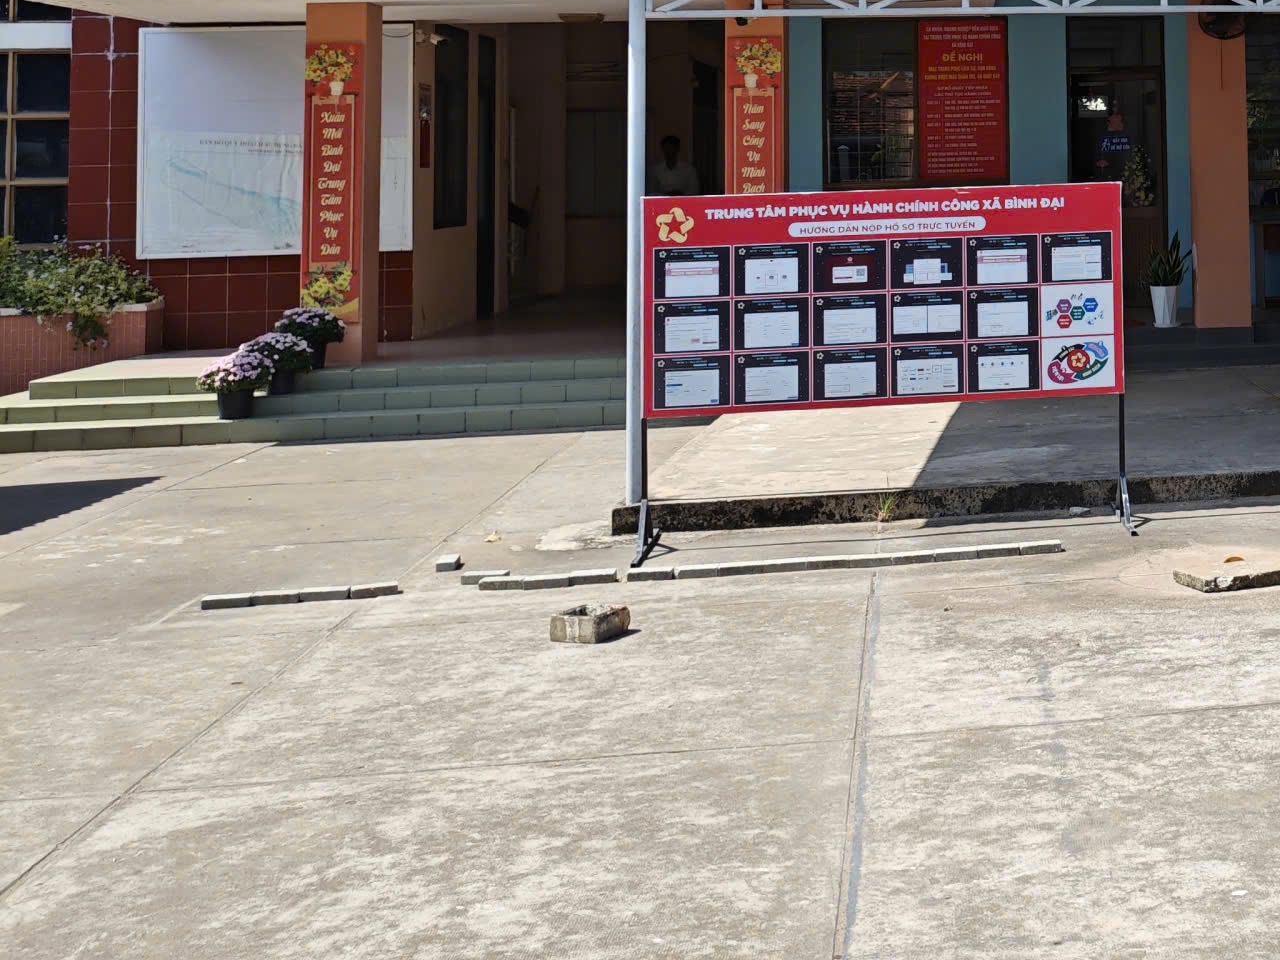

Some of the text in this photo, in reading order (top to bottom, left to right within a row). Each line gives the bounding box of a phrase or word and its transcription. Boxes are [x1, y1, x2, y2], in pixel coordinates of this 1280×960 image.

[320, 112, 345, 123] Xuân
[747, 150, 760, 163] Vụ
[741, 166, 766, 178] Minh
[318, 177, 346, 191] Trung
[320, 194, 342, 206] Tâm
[704, 196, 1065, 220] TRUNG TÂM PHỤC VỤ HÀNH CHÍNH CÔNG XÃ BÌNH ĐẠI
[319, 210, 344, 223] Phục
[902, 222, 915, 231] SƠ
[324, 227, 338, 240] Vụ
